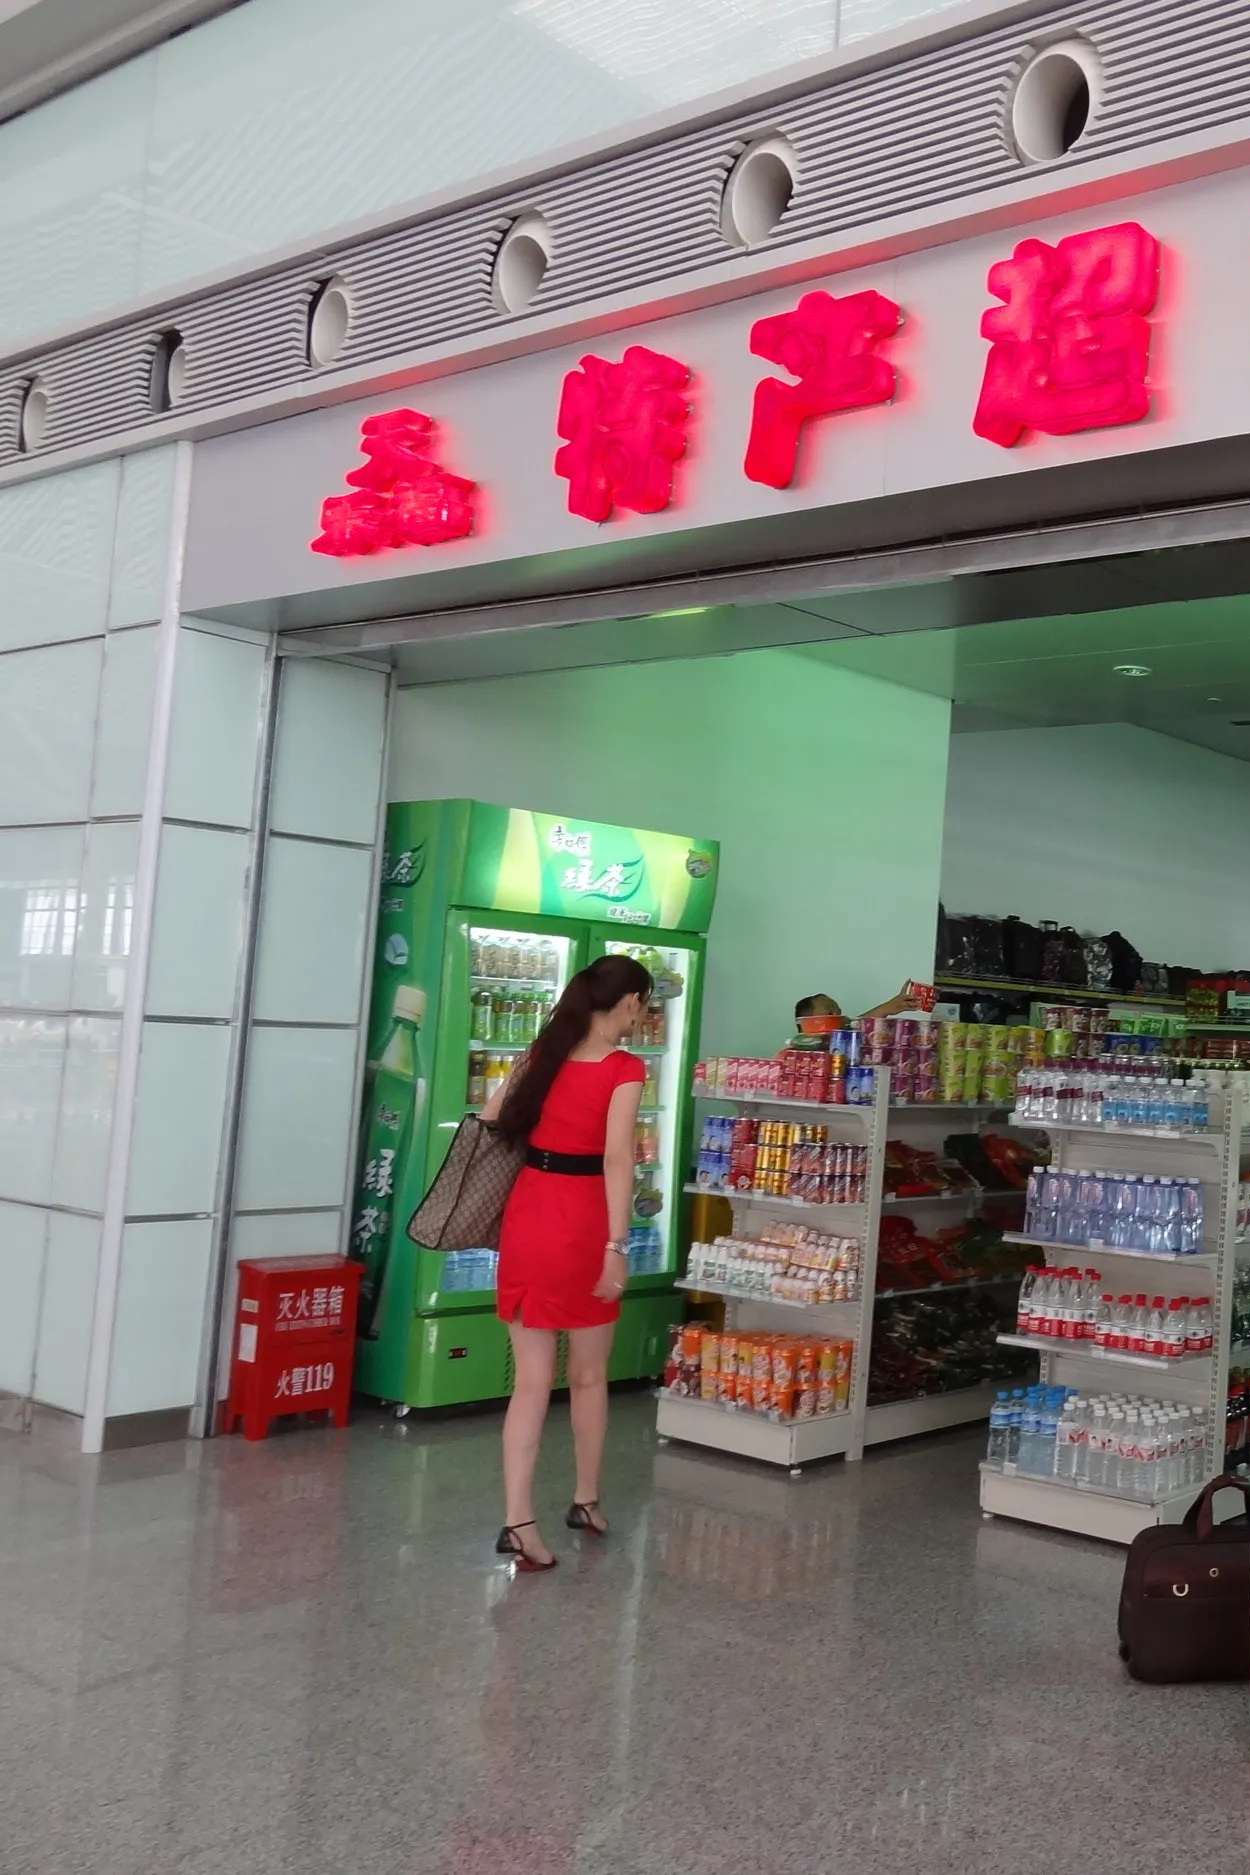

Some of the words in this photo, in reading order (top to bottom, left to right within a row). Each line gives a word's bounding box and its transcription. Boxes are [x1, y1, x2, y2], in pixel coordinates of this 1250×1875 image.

[276, 1285, 345, 1320] 灭火器箱
[274, 1362, 334, 1399] 火警119
